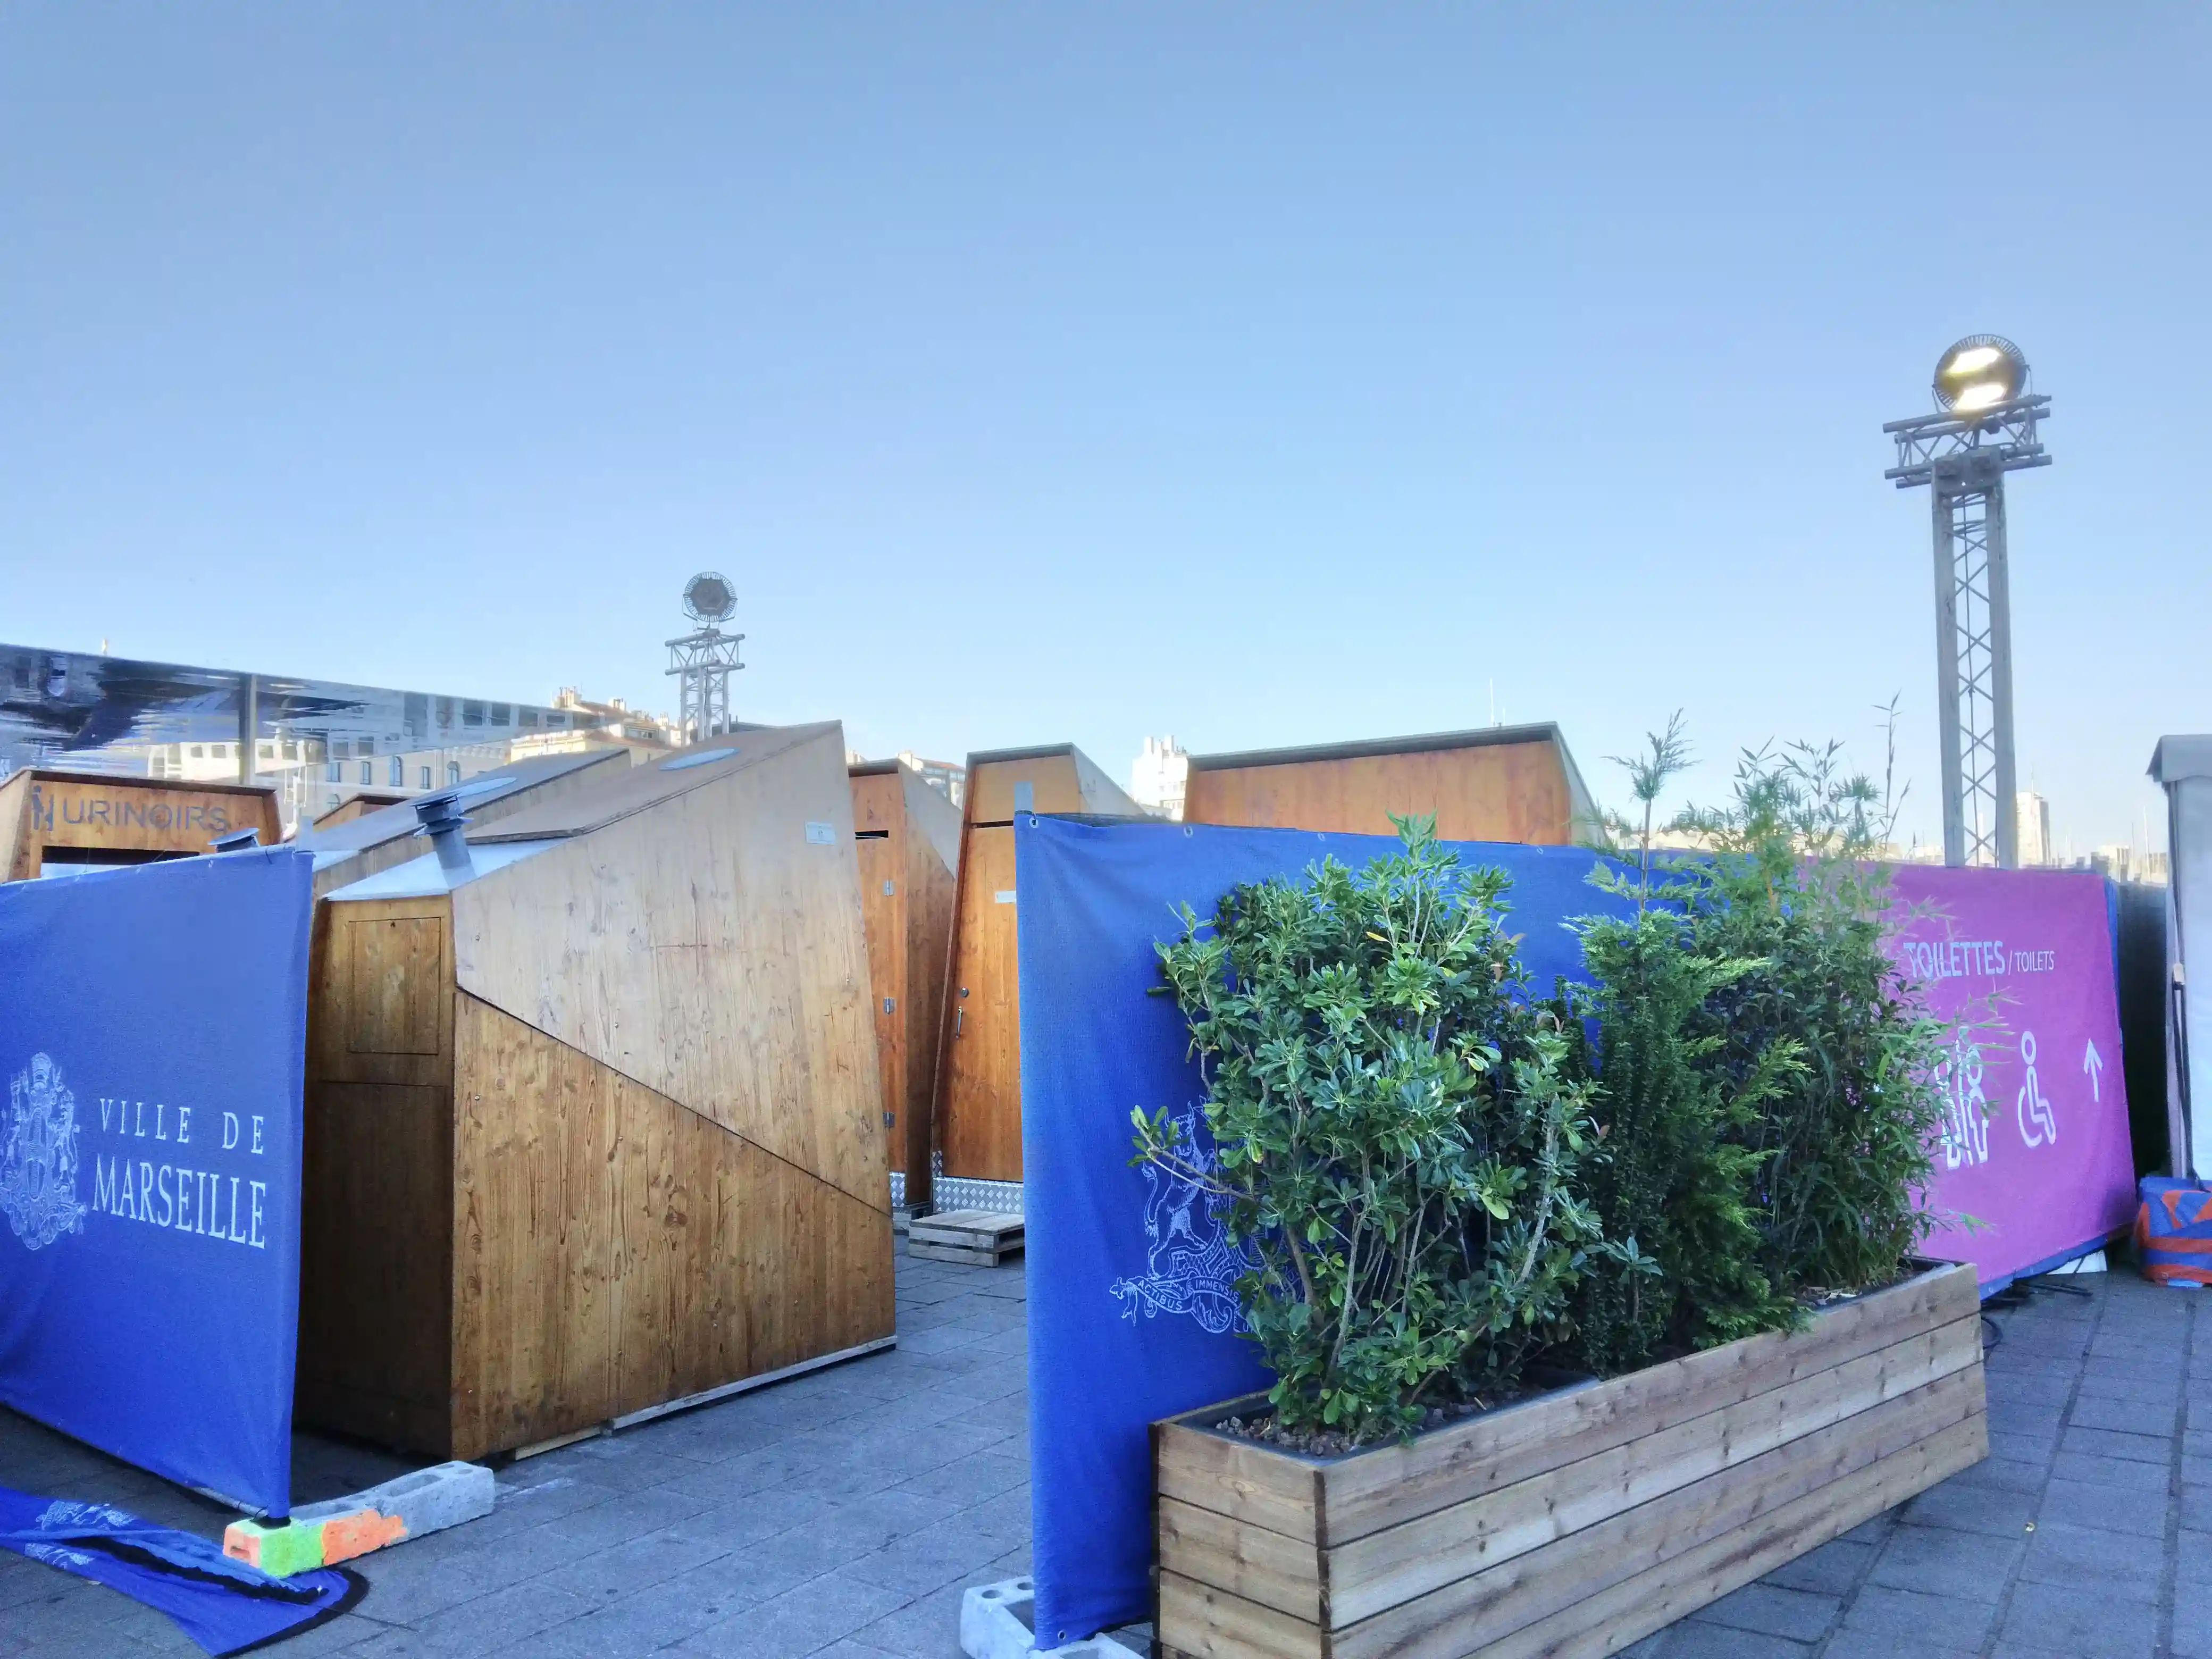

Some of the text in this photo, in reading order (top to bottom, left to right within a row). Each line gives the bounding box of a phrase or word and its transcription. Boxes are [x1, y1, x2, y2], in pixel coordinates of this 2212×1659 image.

[63, 798, 231, 833] URINOIRS
[1904, 940, 2006, 979] TOILETTES
[99, 1098, 264, 1153] VILLE DE
[91, 1153, 266, 1249] MARSEILLE
[1138, 1279, 1183, 1311] ACTIBUS
